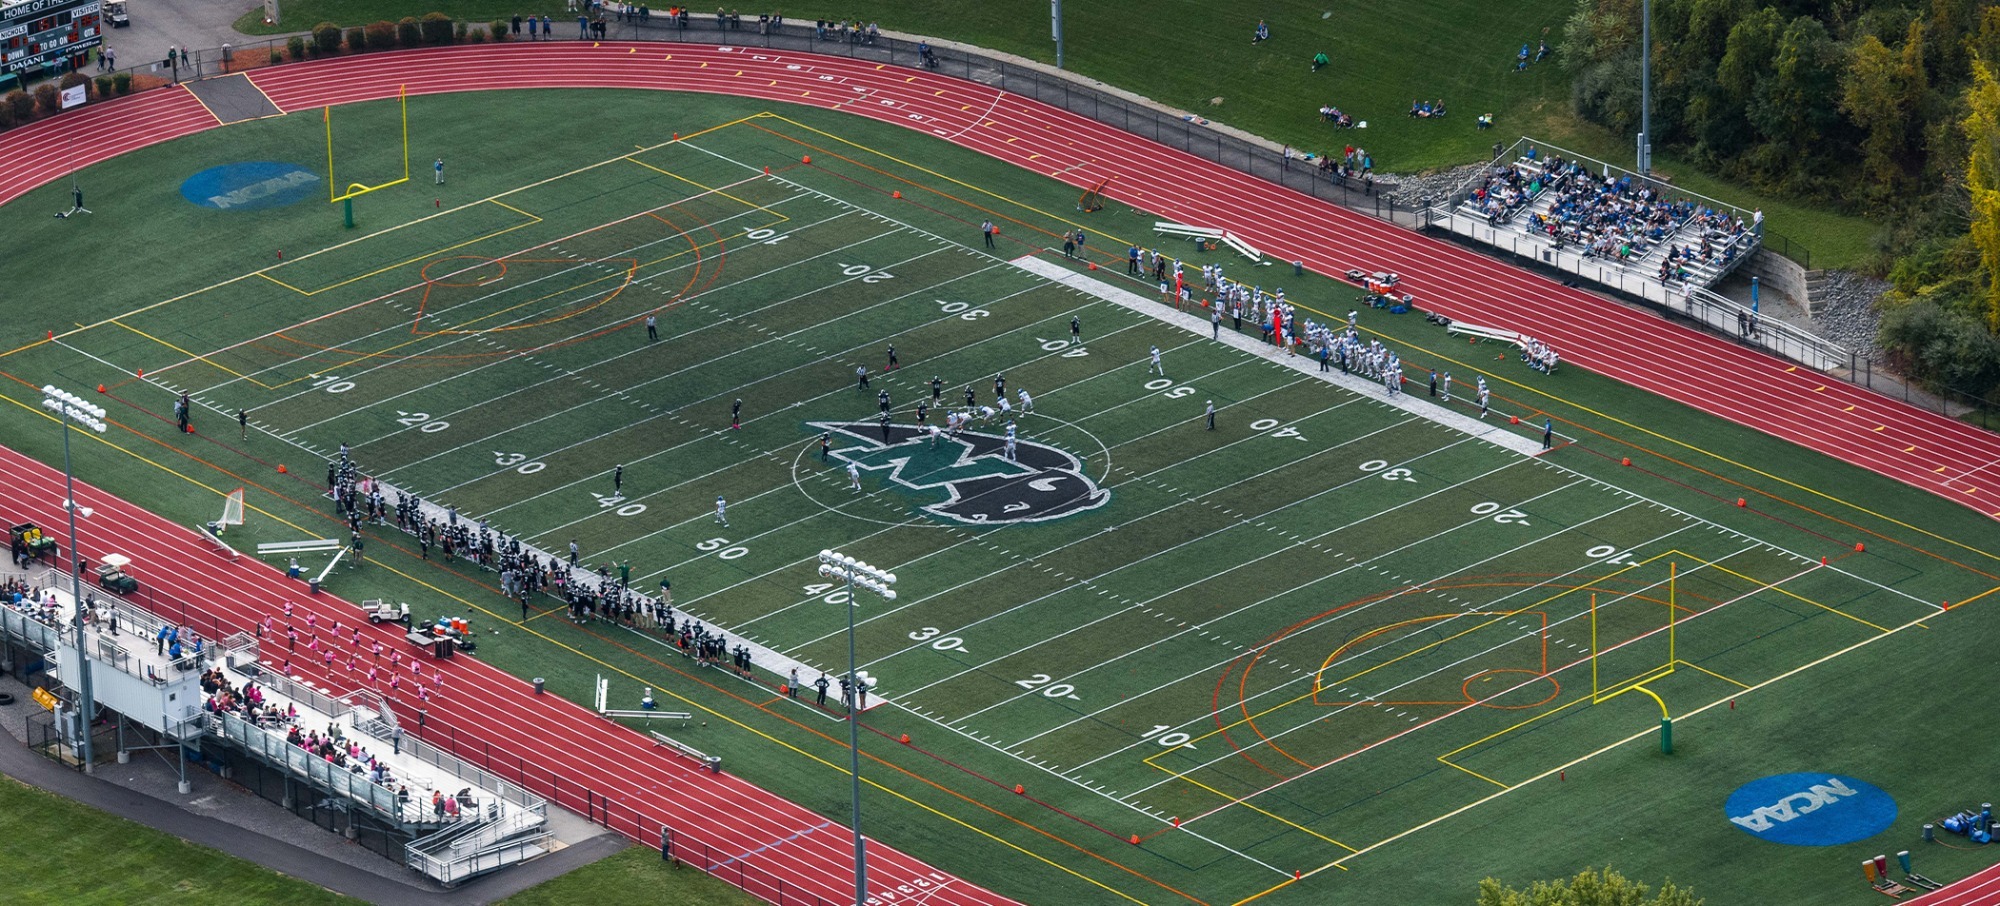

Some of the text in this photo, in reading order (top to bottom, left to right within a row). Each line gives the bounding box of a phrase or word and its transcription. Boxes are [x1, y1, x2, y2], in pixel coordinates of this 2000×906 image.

[4, 4, 31, 19] HOME
[32, 0, 45, 10] OF
[72, 4, 99, 17] VISITOR
[0, 24, 26, 39] NICHOLS
[40, 36, 68, 51] TO GO ON
[7, 49, 24, 61] DOWN
[10, 55, 44, 71] DASANI
[208, 170, 320, 209] NCAA
[747, 229, 789, 245] 10
[843, 265, 894, 283] 20
[941, 302, 990, 320] 30
[1041, 340, 1089, 358] 40
[312, 376, 355, 393] 10
[1144, 379, 1196, 399] 50
[396, 412, 449, 432] 20
[1250, 419, 1300, 437] 40
[496, 453, 546, 474] 30
[1359, 460, 1412, 480] 30
[597, 496, 647, 516] 40
[1470, 502, 1528, 523] 20
[696, 538, 749, 559] 50
[1586, 545, 1633, 565] 10
[803, 583, 855, 604] 40
[909, 627, 963, 650] 30
[1015, 674, 1074, 697] 20
[1141, 725, 1190, 746] 10
[1729, 778, 1858, 833] NCAA
[913, 879, 930, 887] 2
[929, 872, 945, 880] 1
[880, 892, 895, 900] 4
[897, 885, 914, 893] 3
